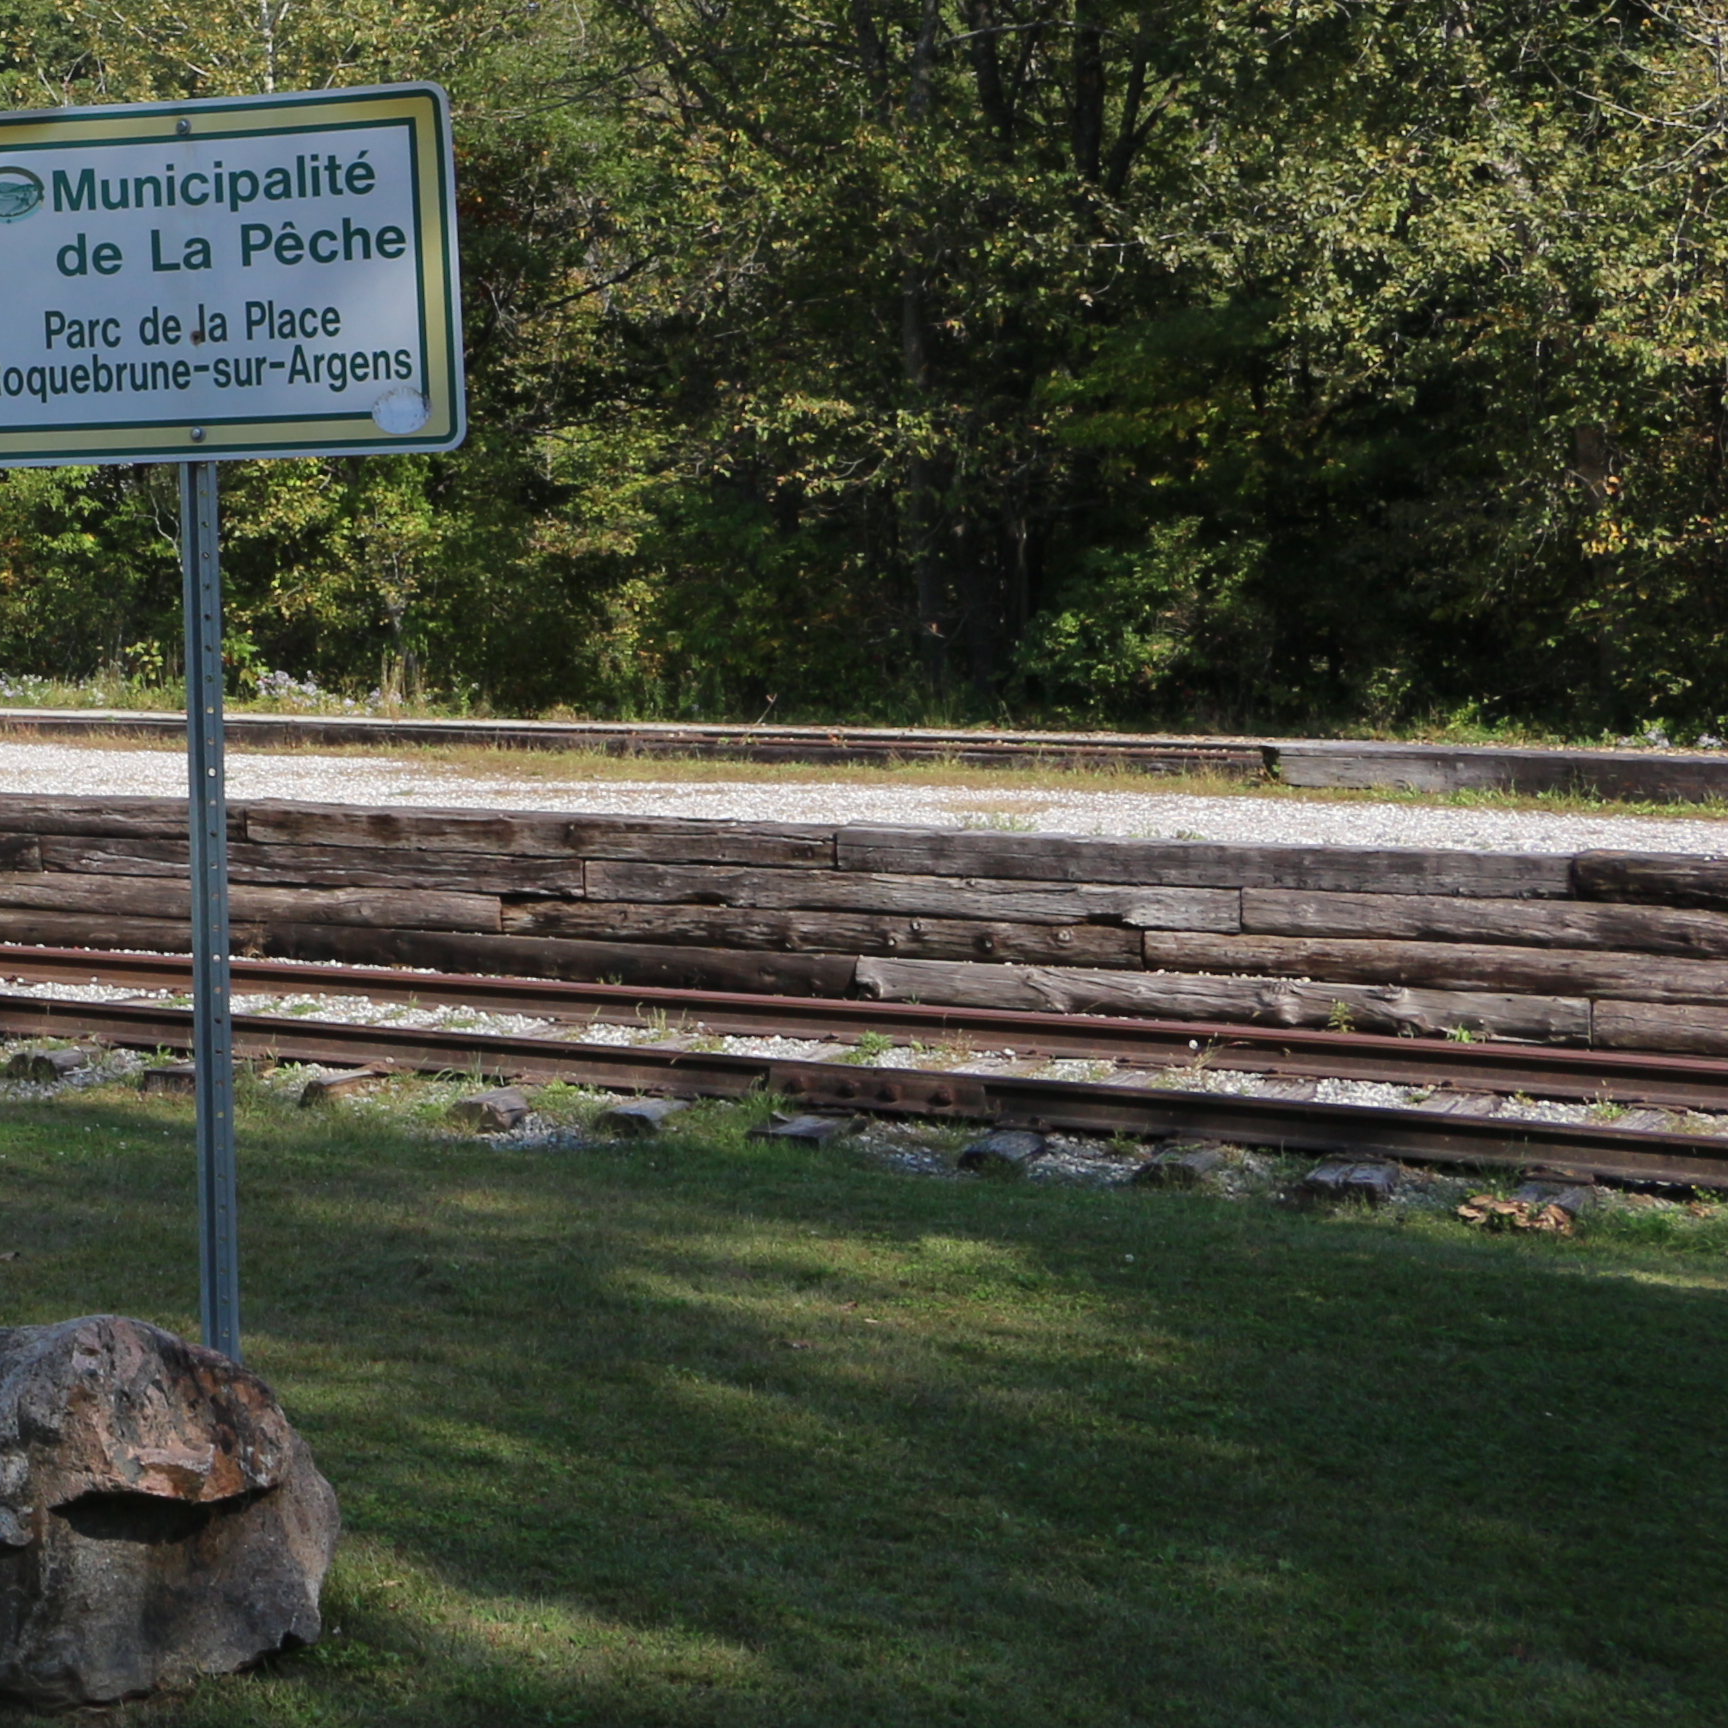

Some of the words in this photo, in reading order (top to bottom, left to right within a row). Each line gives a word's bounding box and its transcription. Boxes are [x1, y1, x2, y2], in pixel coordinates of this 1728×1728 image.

[52, 150, 376, 212] Municipalité
[57, 233, 123, 277] de
[151, 229, 212, 272] La
[241, 217, 407, 267] Pêche
[45, 310, 121, 349] Parc
[139, 306, 182, 346] de
[198, 303, 228, 344] la
[245, 300, 341, 341] Place
